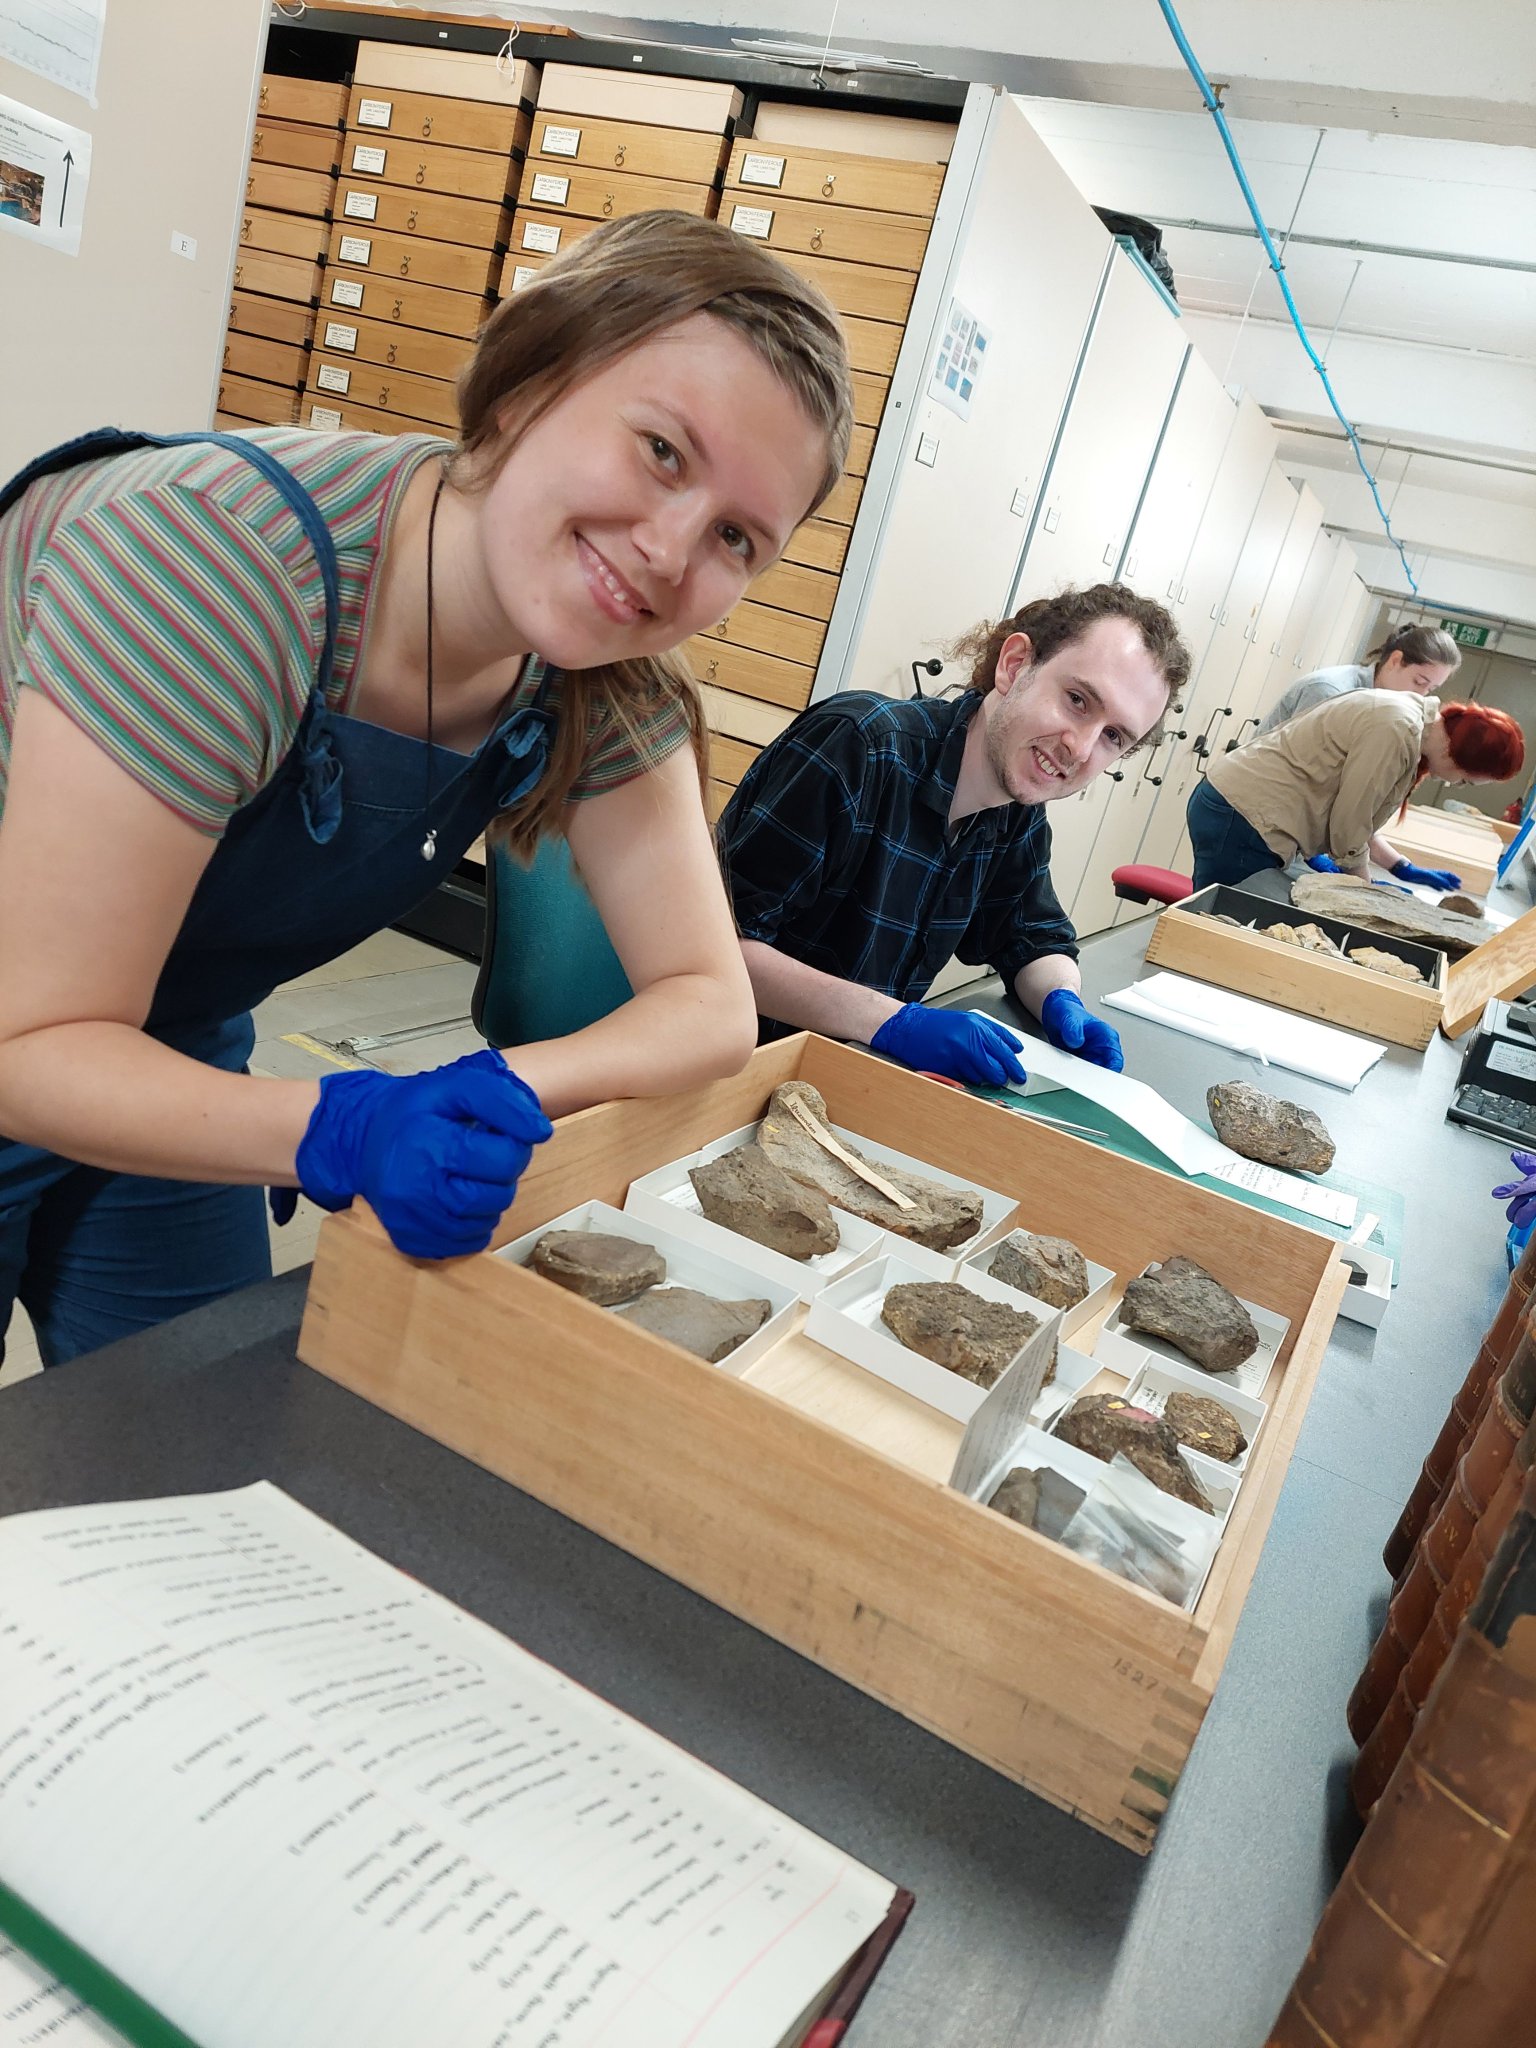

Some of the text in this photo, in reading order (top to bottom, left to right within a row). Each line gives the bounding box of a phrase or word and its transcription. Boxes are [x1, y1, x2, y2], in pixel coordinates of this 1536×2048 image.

[181, 241, 188, 252] E
[1462, 625, 1482, 636] FIRE
[1459, 631, 1479, 644] EXIT
